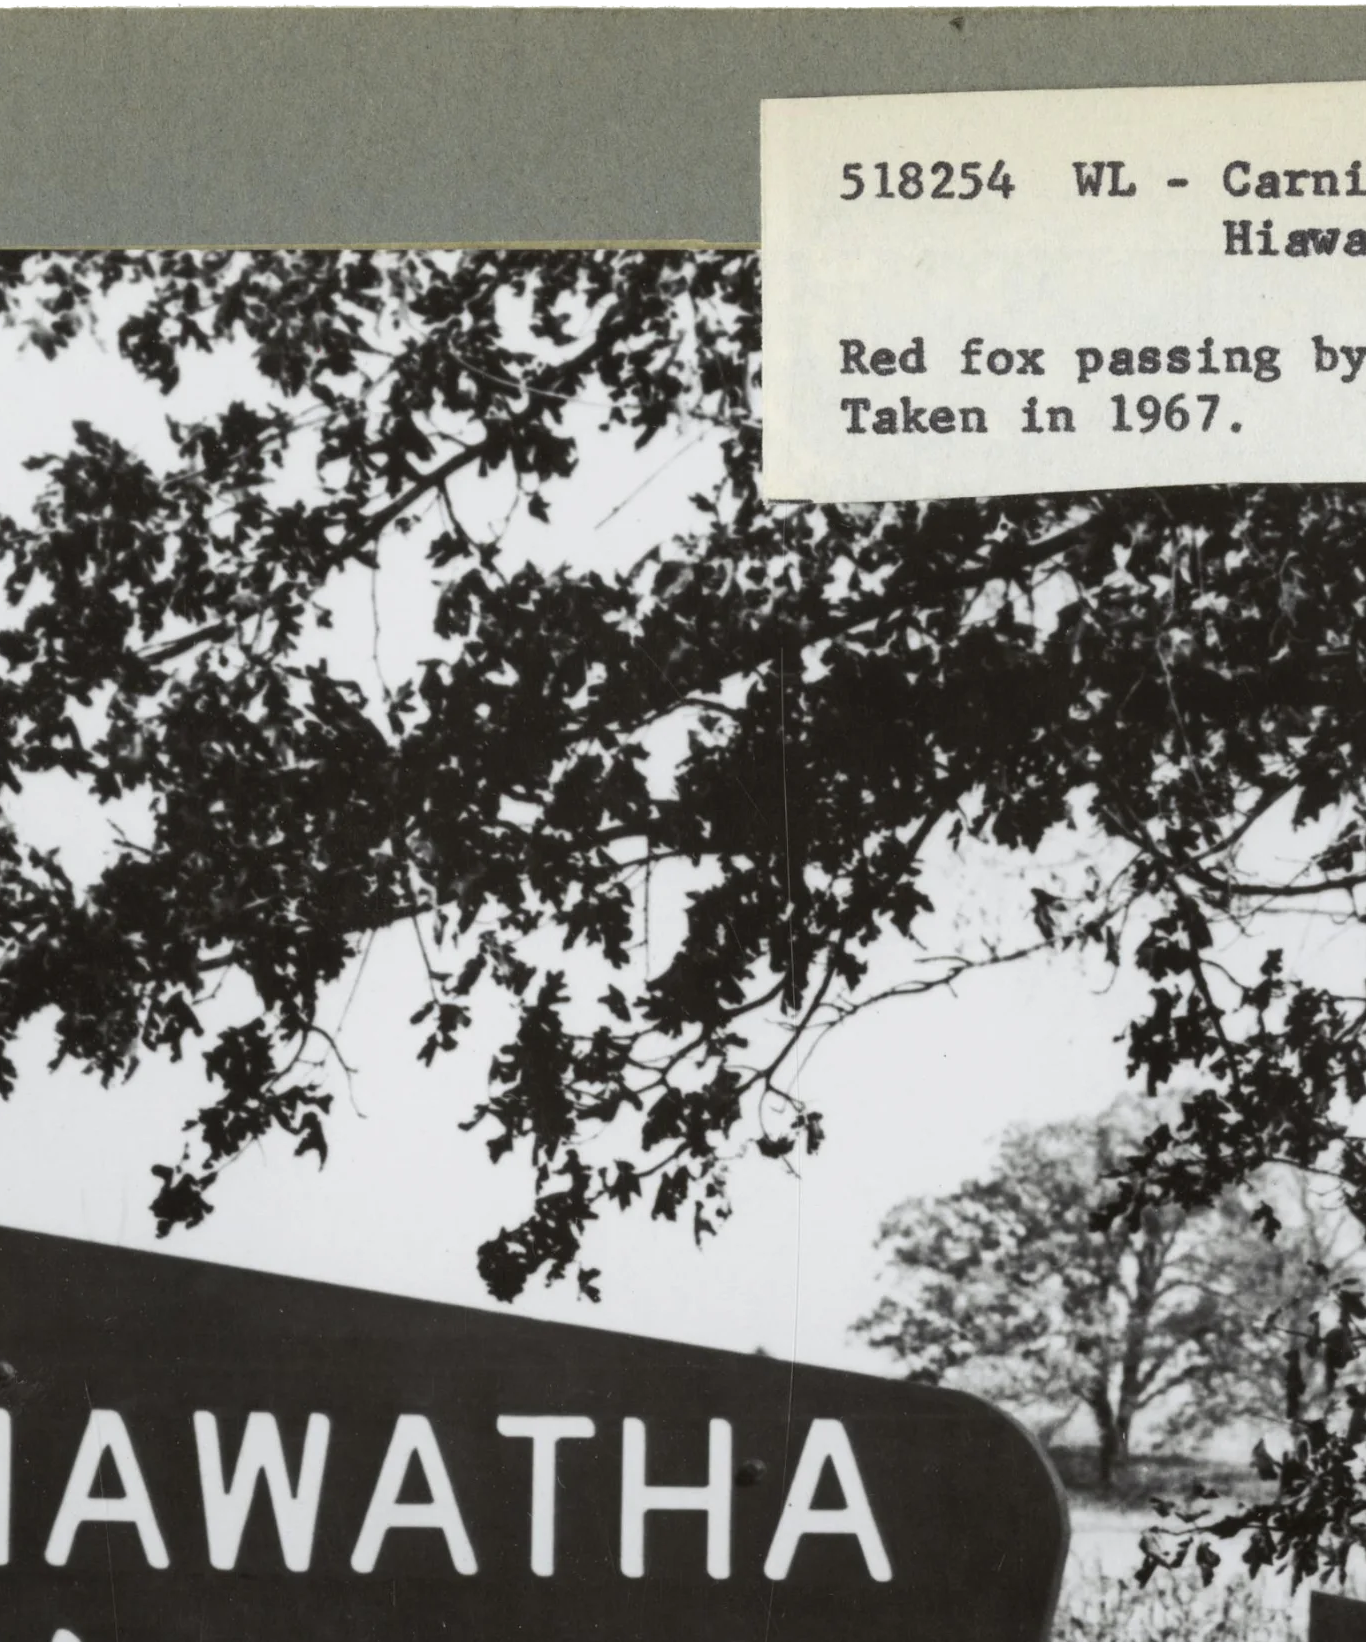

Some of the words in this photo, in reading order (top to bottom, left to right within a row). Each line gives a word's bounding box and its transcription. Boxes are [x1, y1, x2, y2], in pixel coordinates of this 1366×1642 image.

[841, 160, 1015, 200] 518254
[1073, 161, 1136, 196] WL
[840, 337, 926, 376] Red
[961, 338, 1044, 375] fox
[1076, 337, 1280, 383] passing
[841, 397, 987, 434] Taken
[1022, 397, 1075, 433] in
[1111, 393, 1241, 433] 1967.
